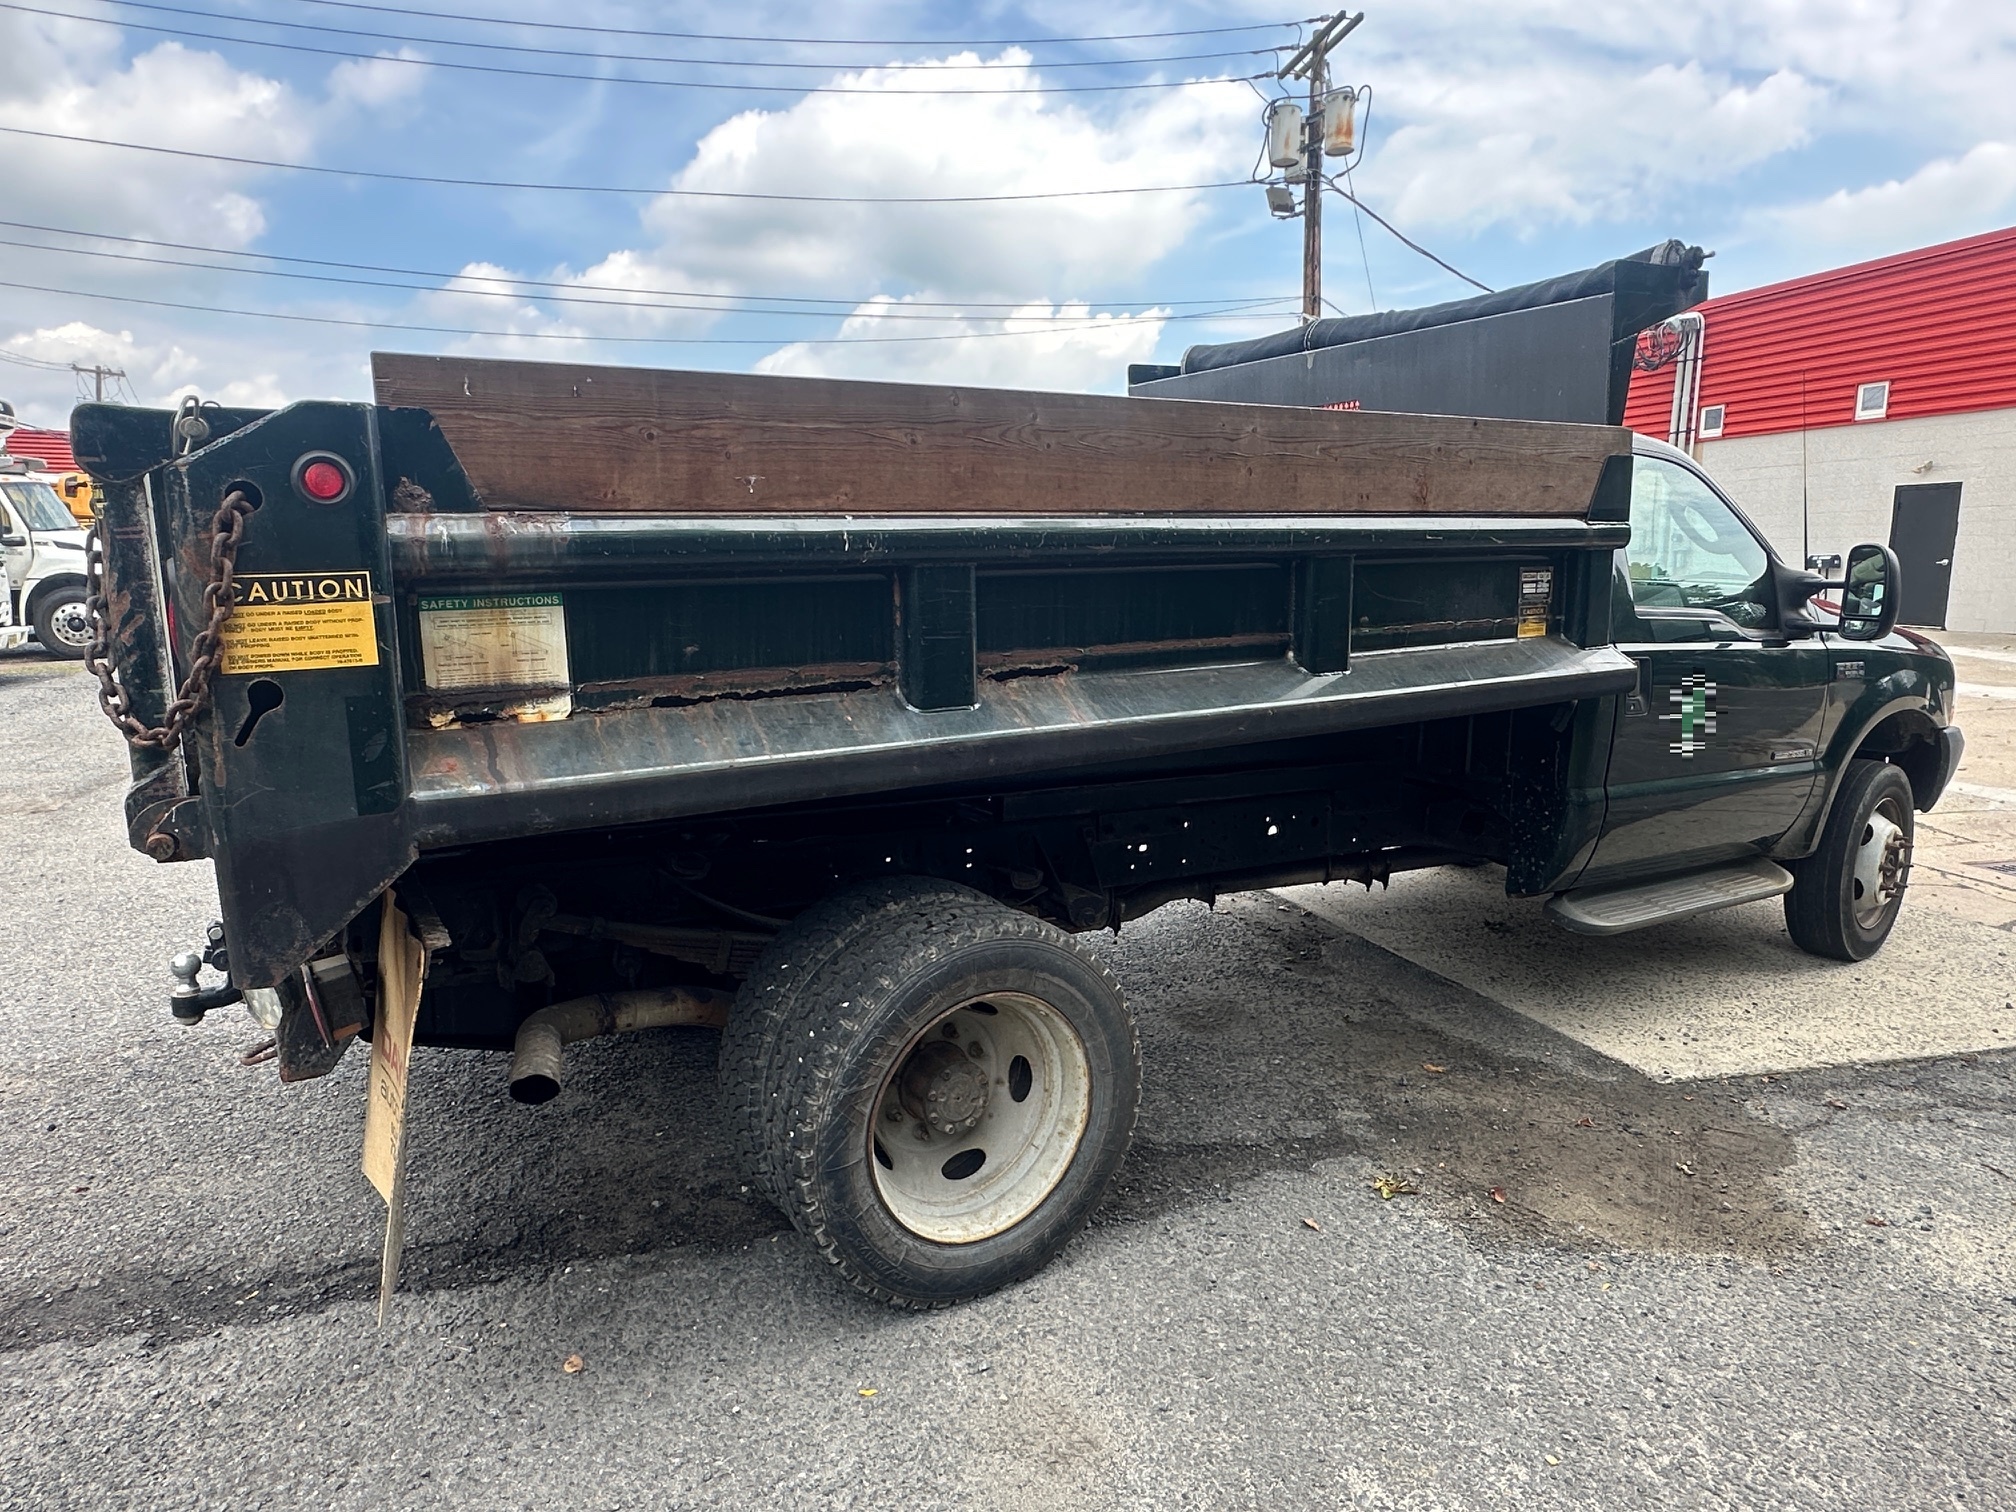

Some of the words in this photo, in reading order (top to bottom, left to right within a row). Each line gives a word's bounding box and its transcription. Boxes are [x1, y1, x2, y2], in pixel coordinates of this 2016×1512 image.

[231, 578, 363, 603] CAUTION
[421, 599, 468, 610] SAFETY
[473, 596, 560, 608] INSTRUCTIONS
